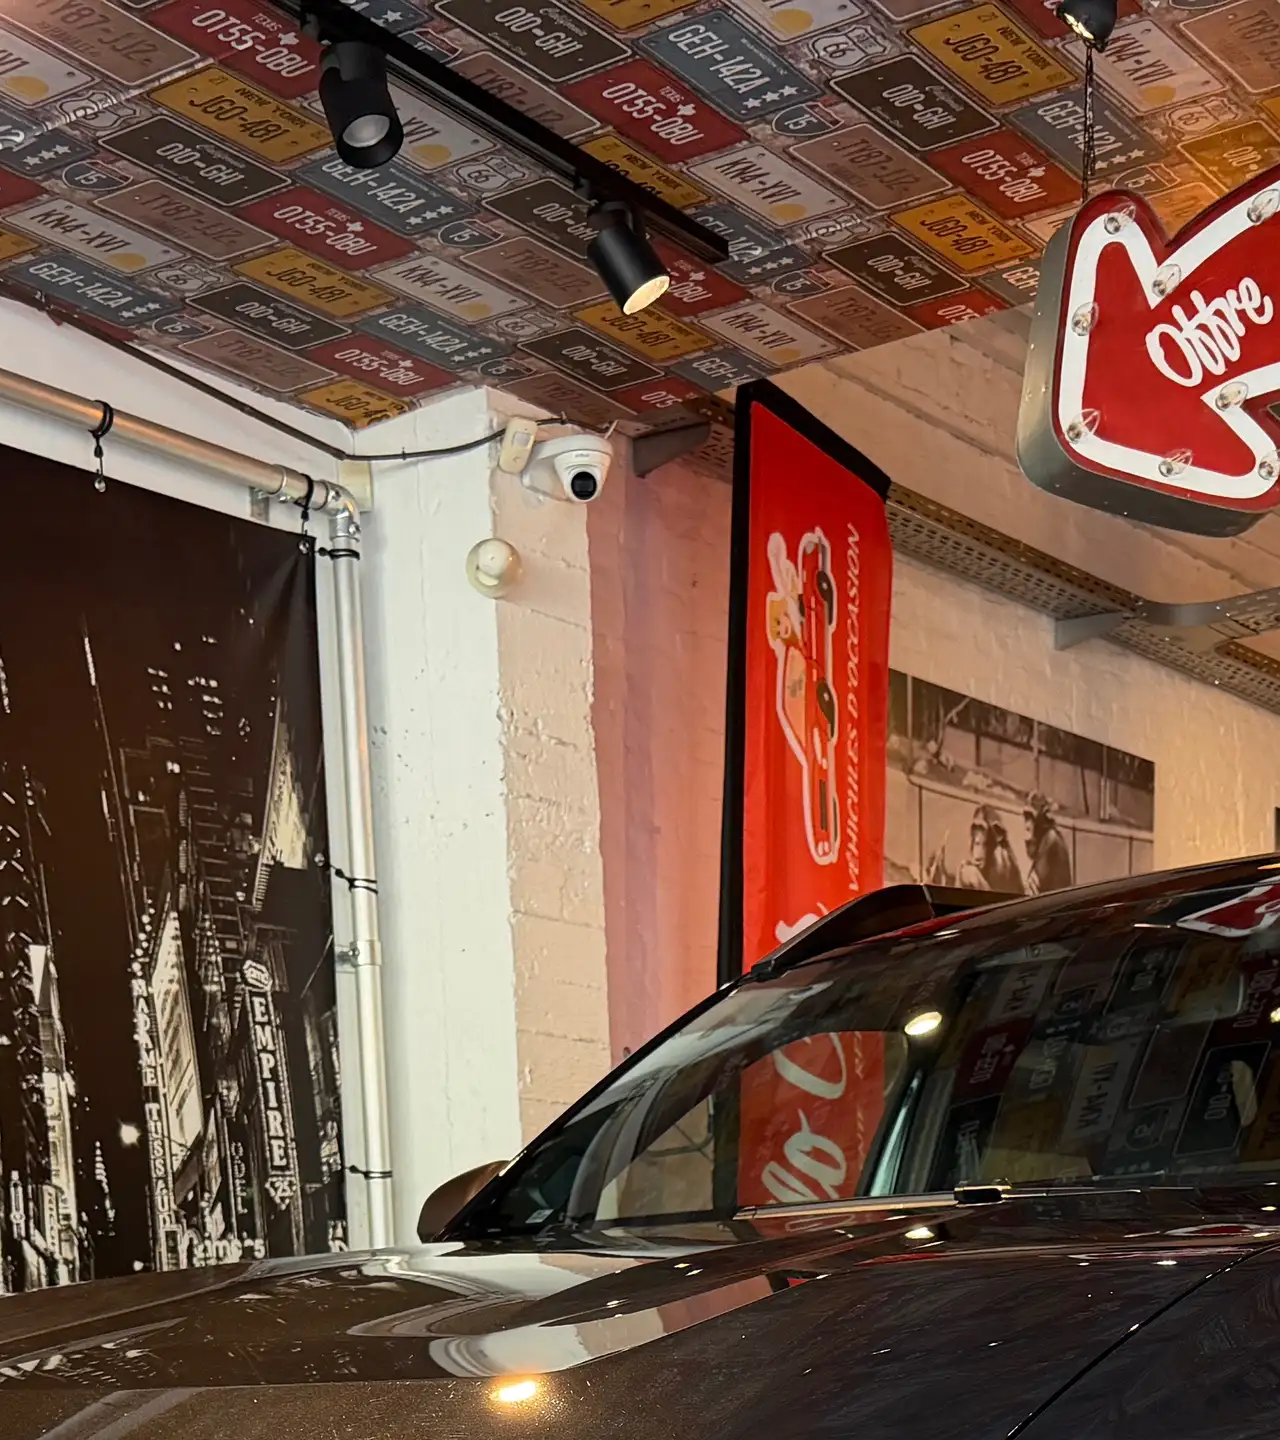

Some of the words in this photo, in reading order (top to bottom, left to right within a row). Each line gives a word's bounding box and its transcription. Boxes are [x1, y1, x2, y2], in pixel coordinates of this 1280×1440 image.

[252, 13, 281, 31] TEXAS
[823, 42, 850, 58] 66
[997, 26, 1023, 46] NEW
[1021, 46, 1053, 70] YORK
[669, 24, 770, 94] GEH-142A
[235, 87, 271, 107] NEW
[273, 105, 309, 128] YORK
[785, 115, 817, 130] 15
[623, 153, 652, 171] NEW
[75, 171, 106, 184] 15
[468, 169, 497, 184] 66
[450, 228, 472, 240] 15
[29, 262, 133, 308] GEH-142A
[782, 277, 811, 291] 15
[782, 278, 811, 291] 15
[164, 321, 191, 332] 15
[378, 314, 468, 353] GEH-142A
[1145, 275, 1274, 389] Offre
[847, 523, 861, 720] D'OCCASION
[252, 996, 288, 1167] EMPIRE
[273, 1180, 291, 1197] 25
